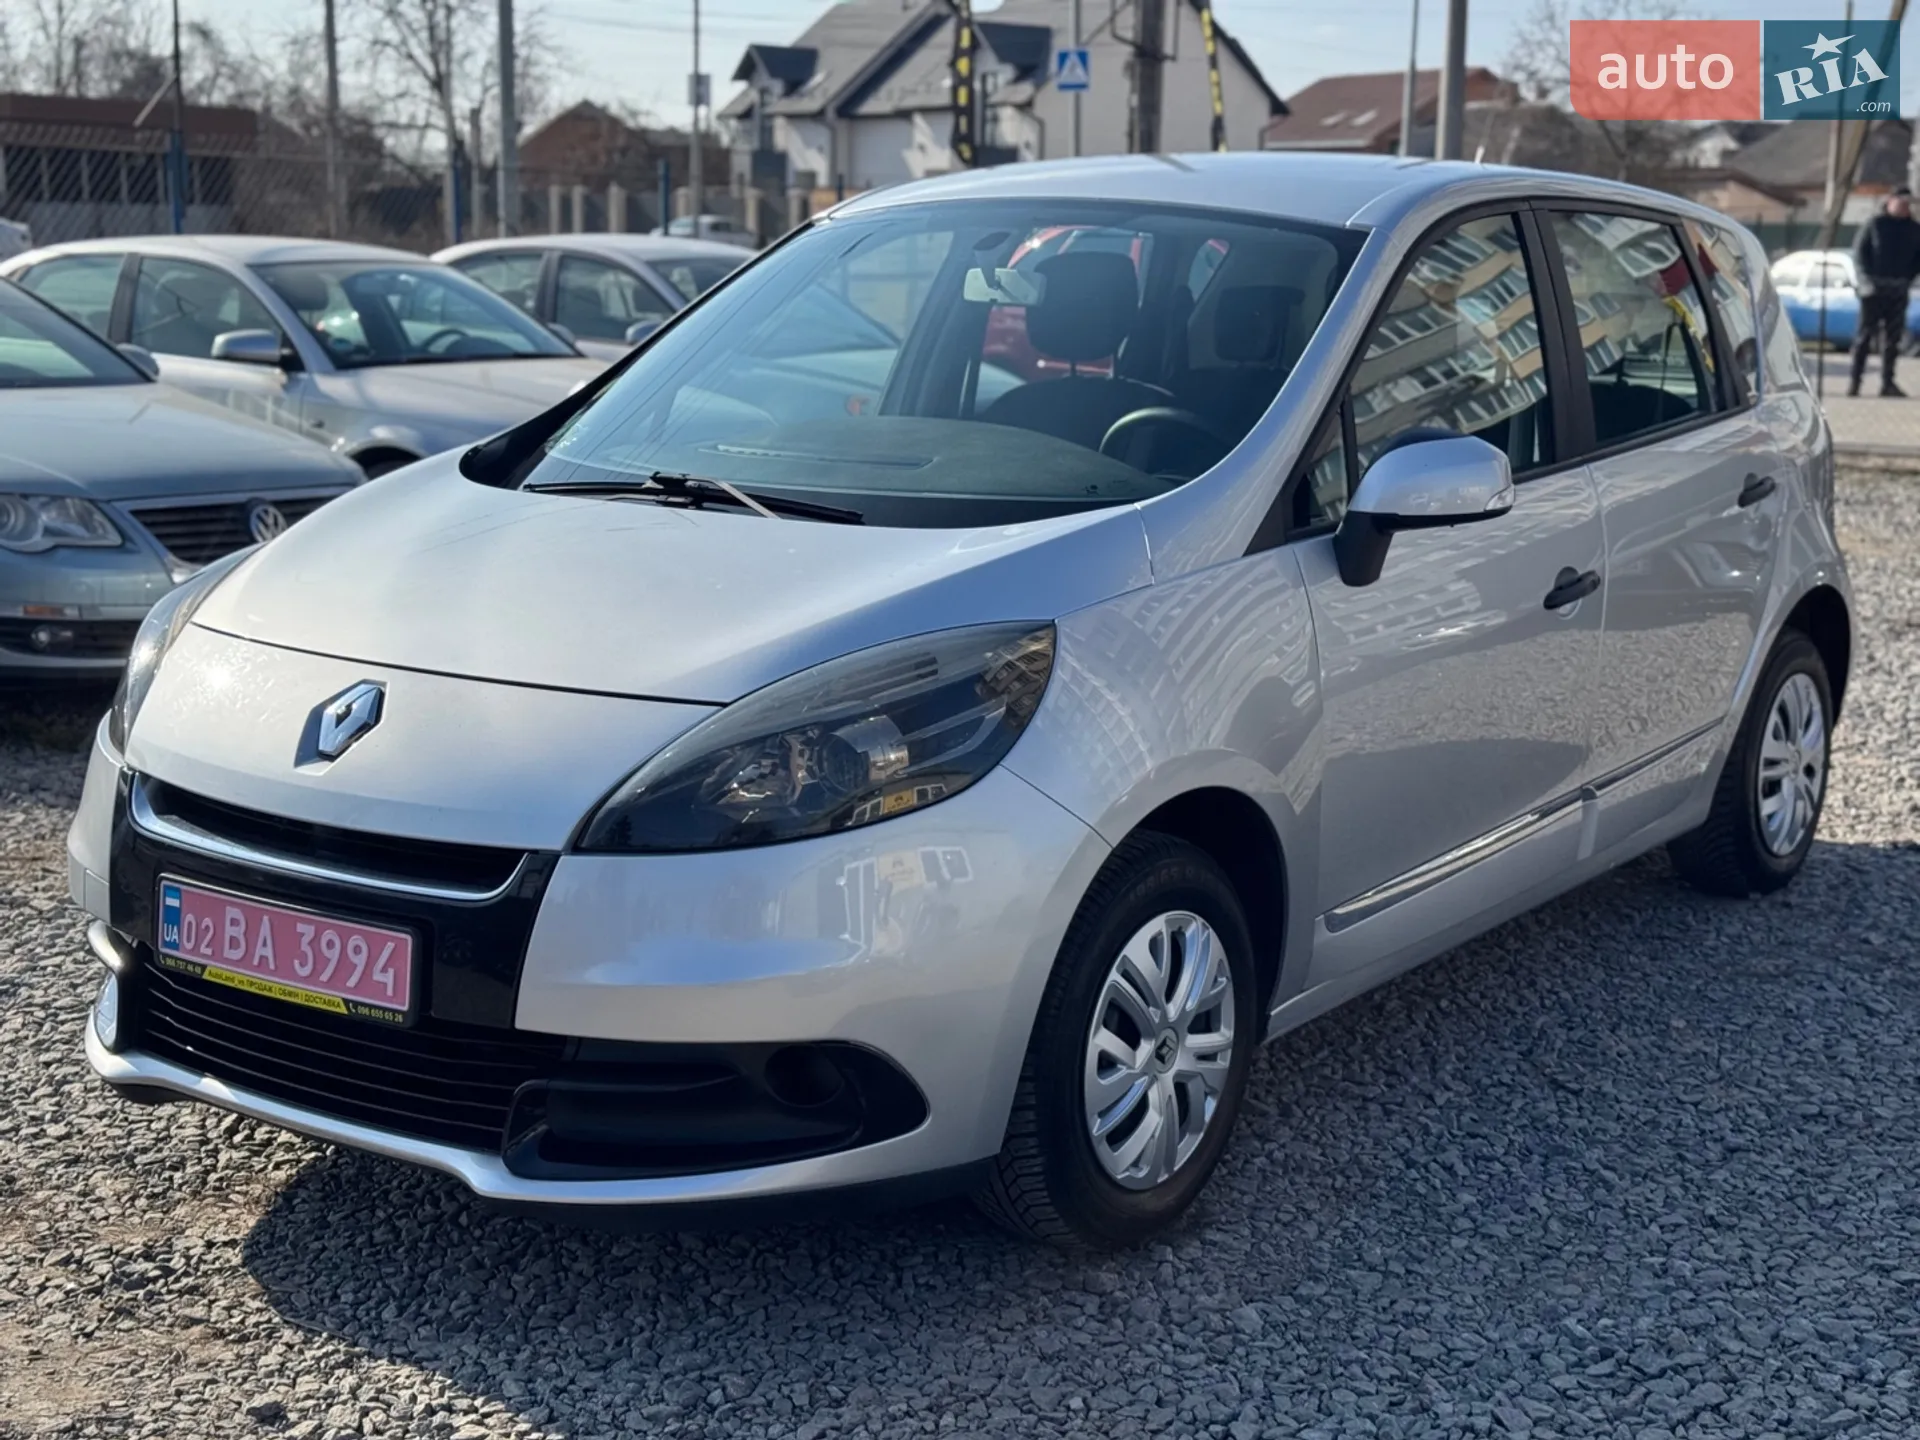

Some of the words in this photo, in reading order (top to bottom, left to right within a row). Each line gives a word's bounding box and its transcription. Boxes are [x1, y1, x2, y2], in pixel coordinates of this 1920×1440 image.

[163, 923, 180, 944] UA
[182, 913, 215, 957] 02
[223, 905, 277, 971] BA
[293, 921, 396, 997] 3994
